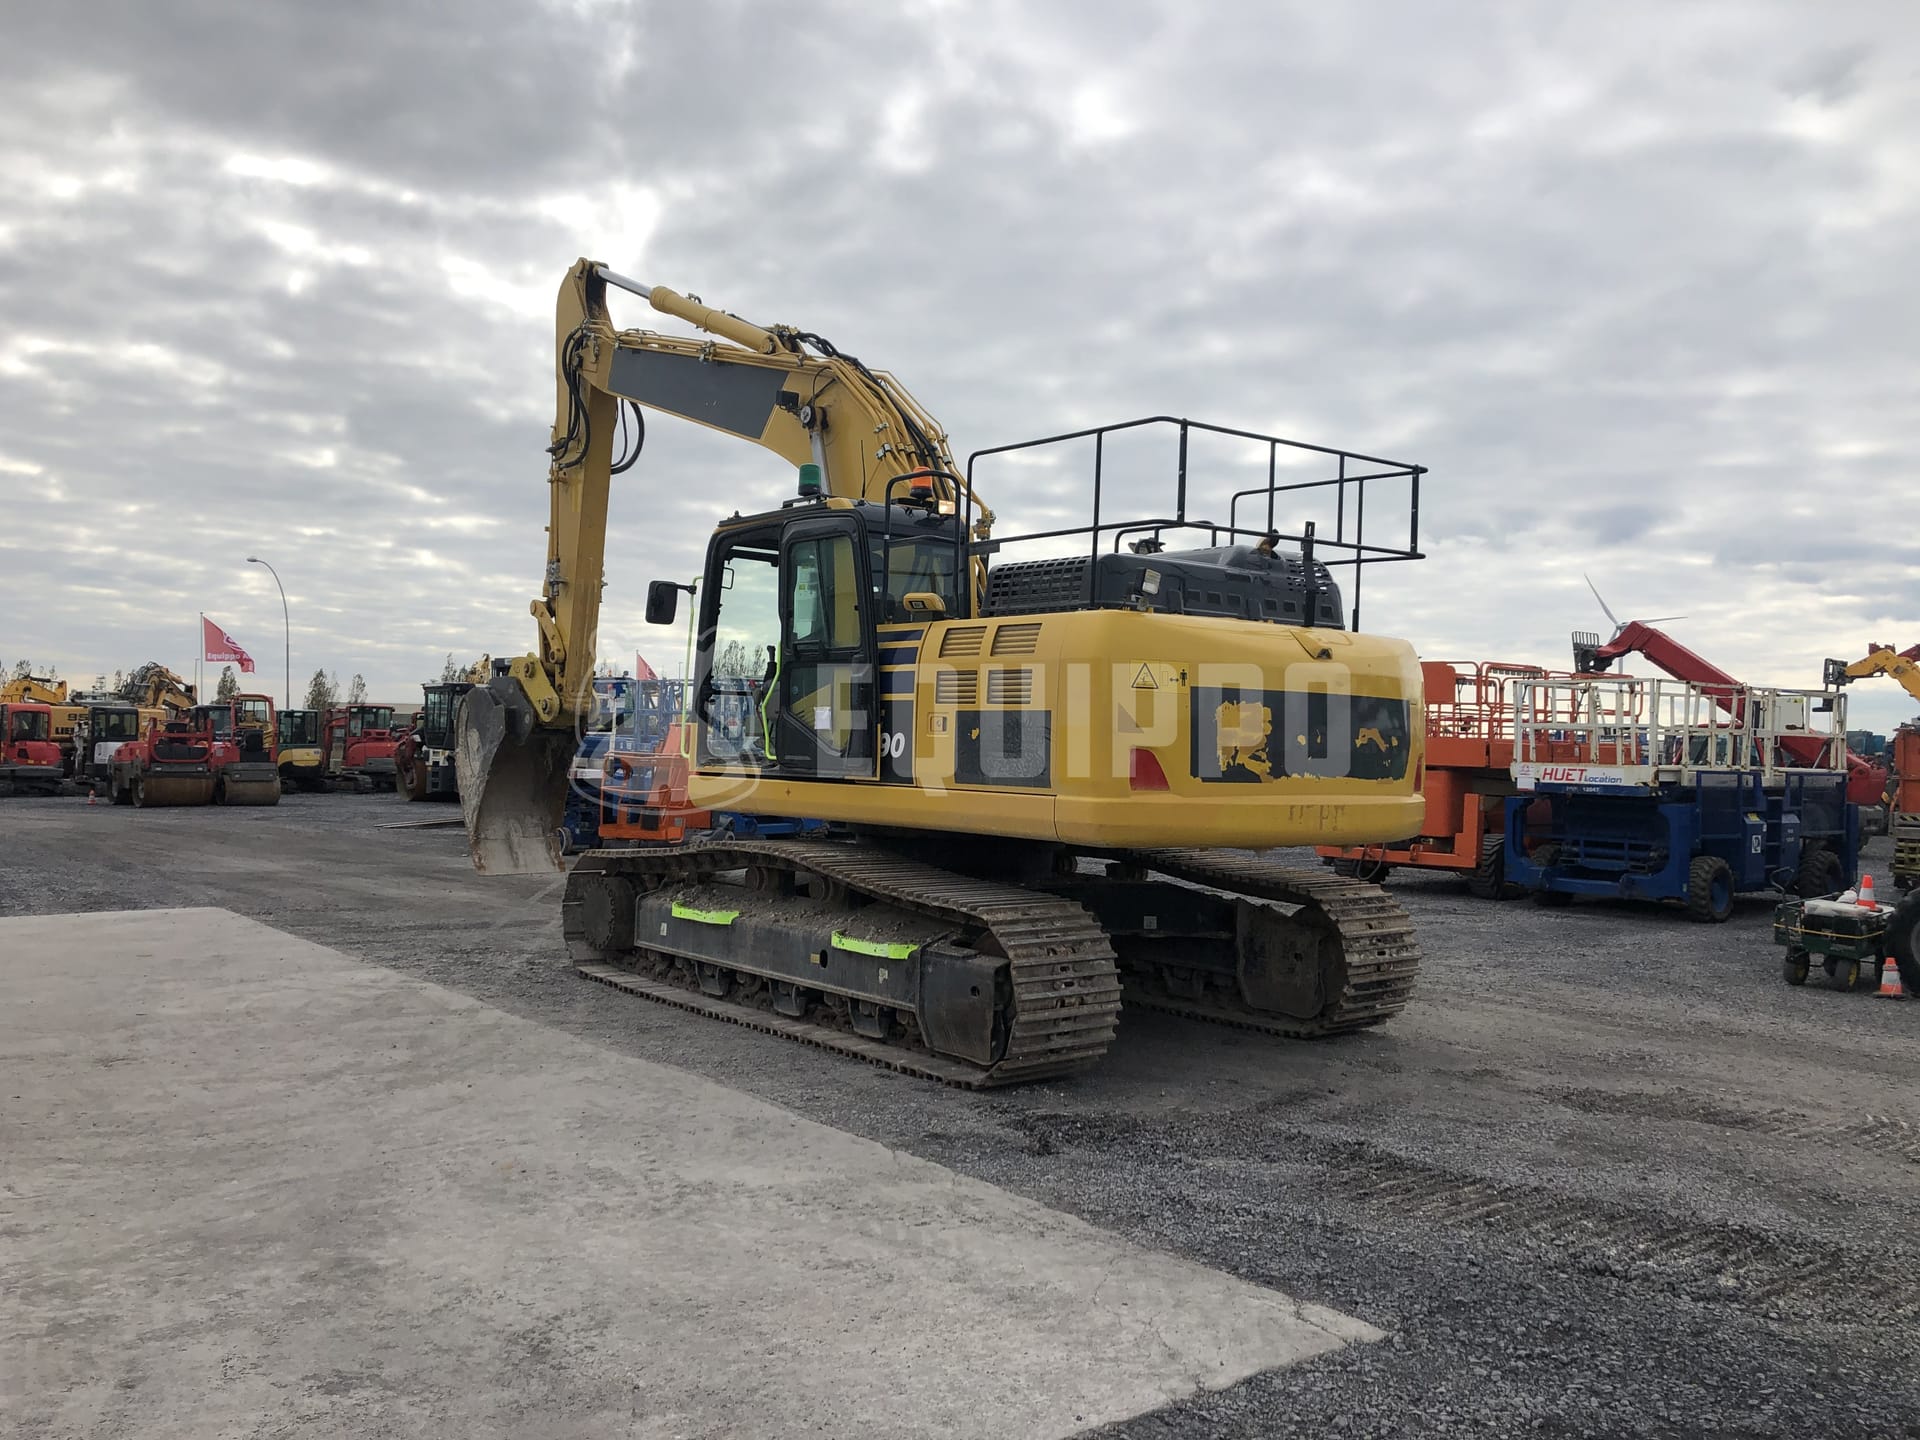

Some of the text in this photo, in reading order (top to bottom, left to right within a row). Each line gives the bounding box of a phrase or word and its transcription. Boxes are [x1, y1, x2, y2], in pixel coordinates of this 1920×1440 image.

[207, 652, 241, 661] Equippo
[1542, 768, 1623, 784] HUET Location
